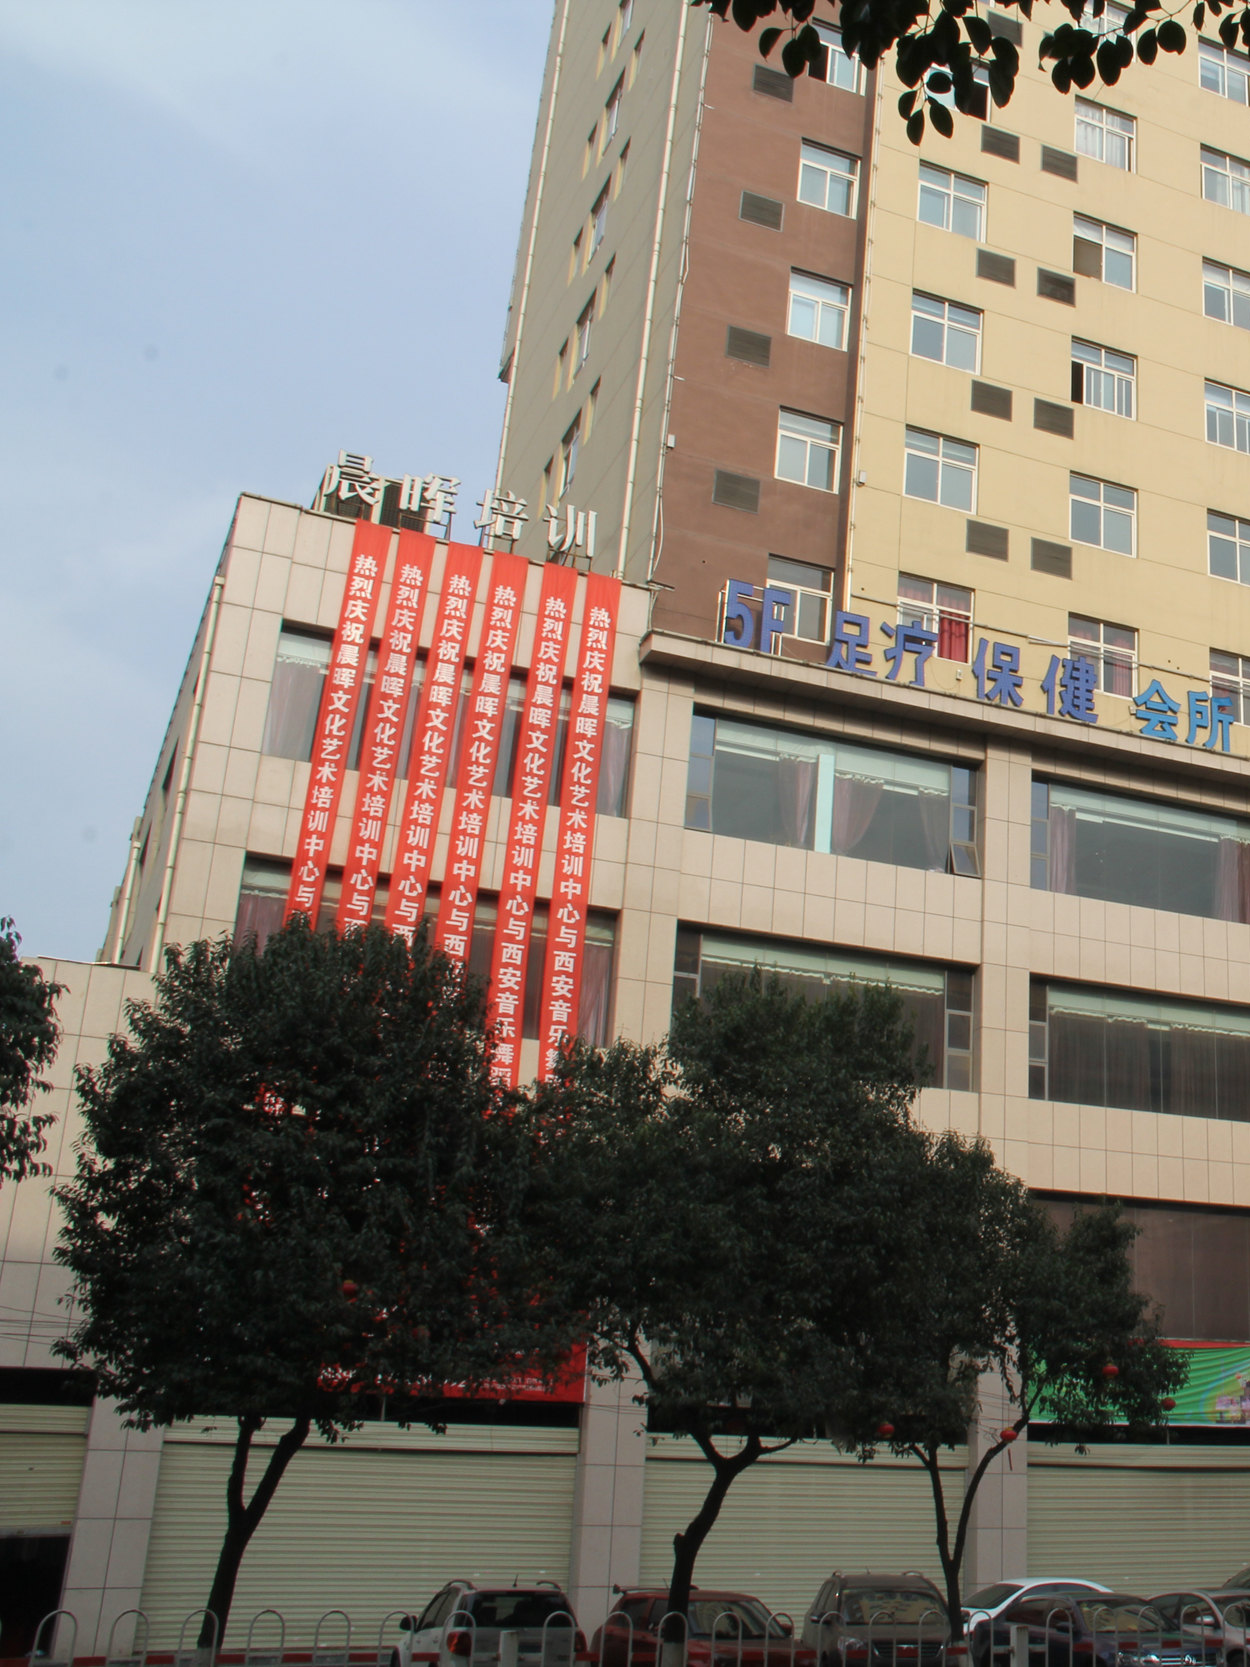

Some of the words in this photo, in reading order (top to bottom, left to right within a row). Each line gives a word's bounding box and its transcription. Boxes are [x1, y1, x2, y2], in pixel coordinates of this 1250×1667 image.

[324, 448, 598, 558] 晨晖培训
[292, 554, 378, 922] 热烈庆祝晨晖文化艺术培训中心与
[440, 585, 517, 984] 热烈庆祝晨晖文化艺术培训中心与西
